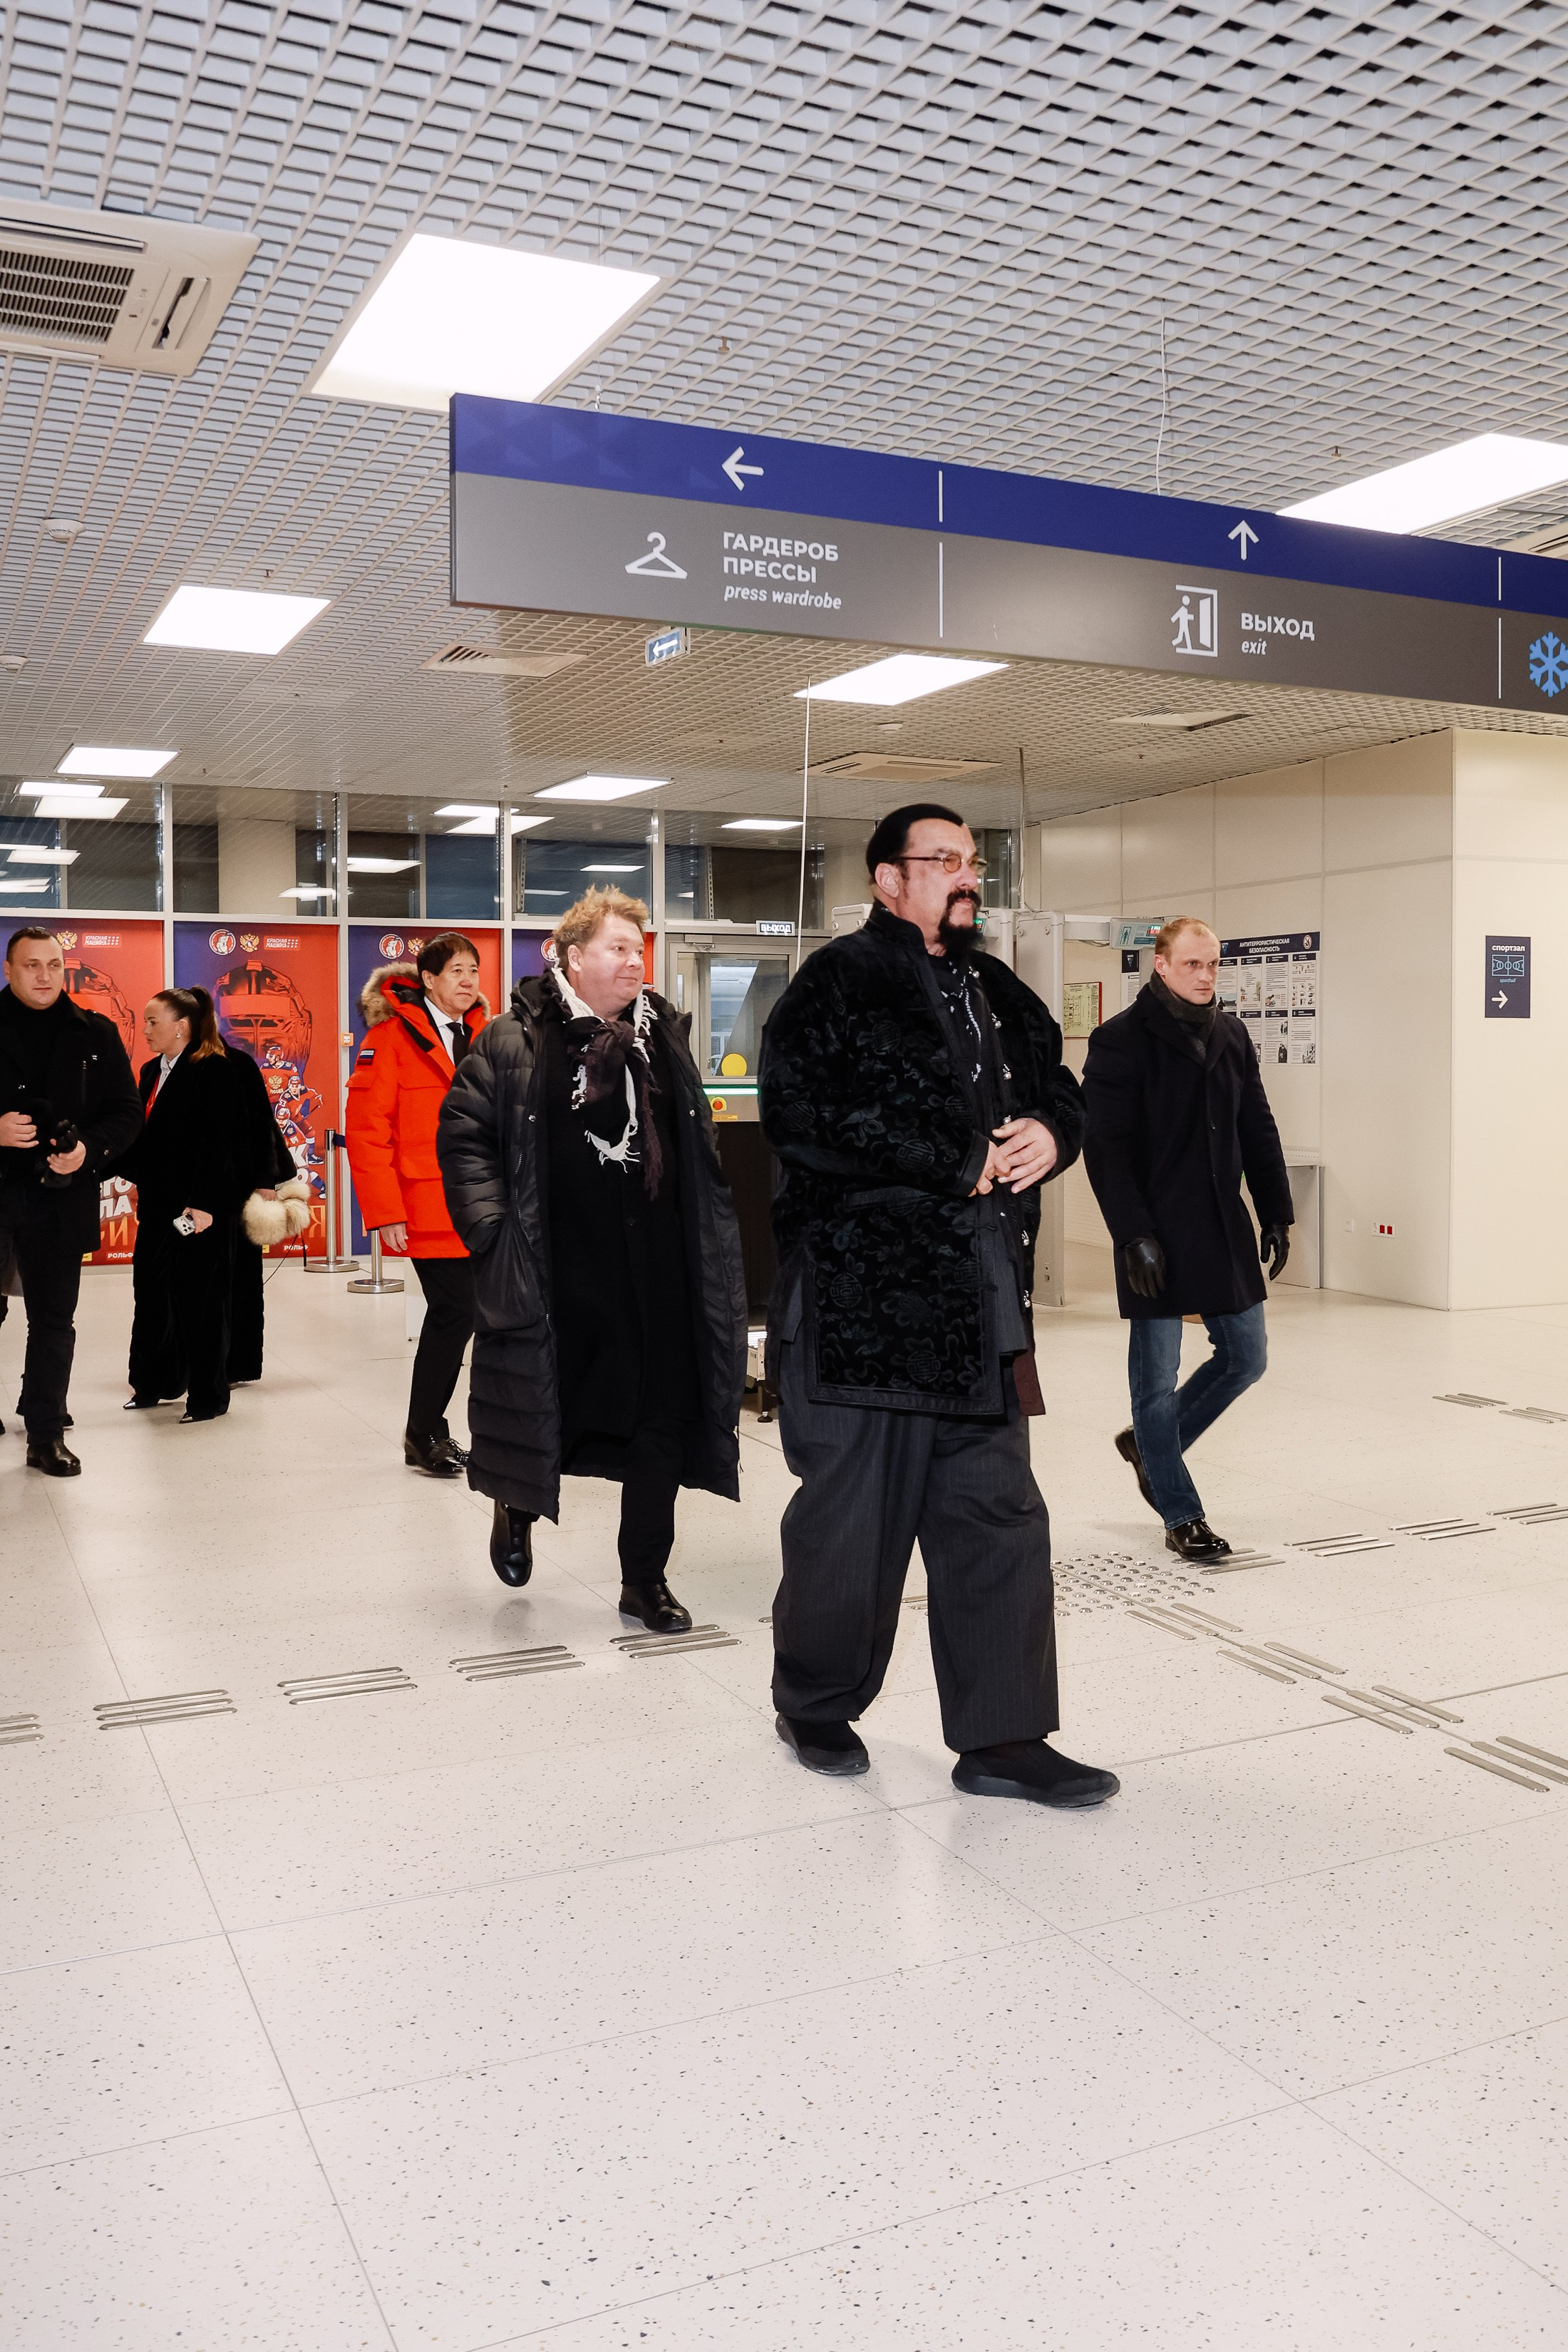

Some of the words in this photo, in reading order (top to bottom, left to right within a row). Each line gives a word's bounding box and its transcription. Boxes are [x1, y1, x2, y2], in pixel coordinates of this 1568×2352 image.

[723, 532, 839, 562] ГАРДЕРОБ
[723, 557, 817, 583] ПРЕССЫ
[724, 585, 768, 602] press
[772, 589, 842, 609] wardrobe
[1242, 613, 1315, 641] ВЫХОД
[1242, 638, 1267, 655] exit
[760, 924, 791, 932] ВЫХОД
[1239, 938, 1290, 947] АНТИТЕРРОРИСТИЧЕСКАЯ
